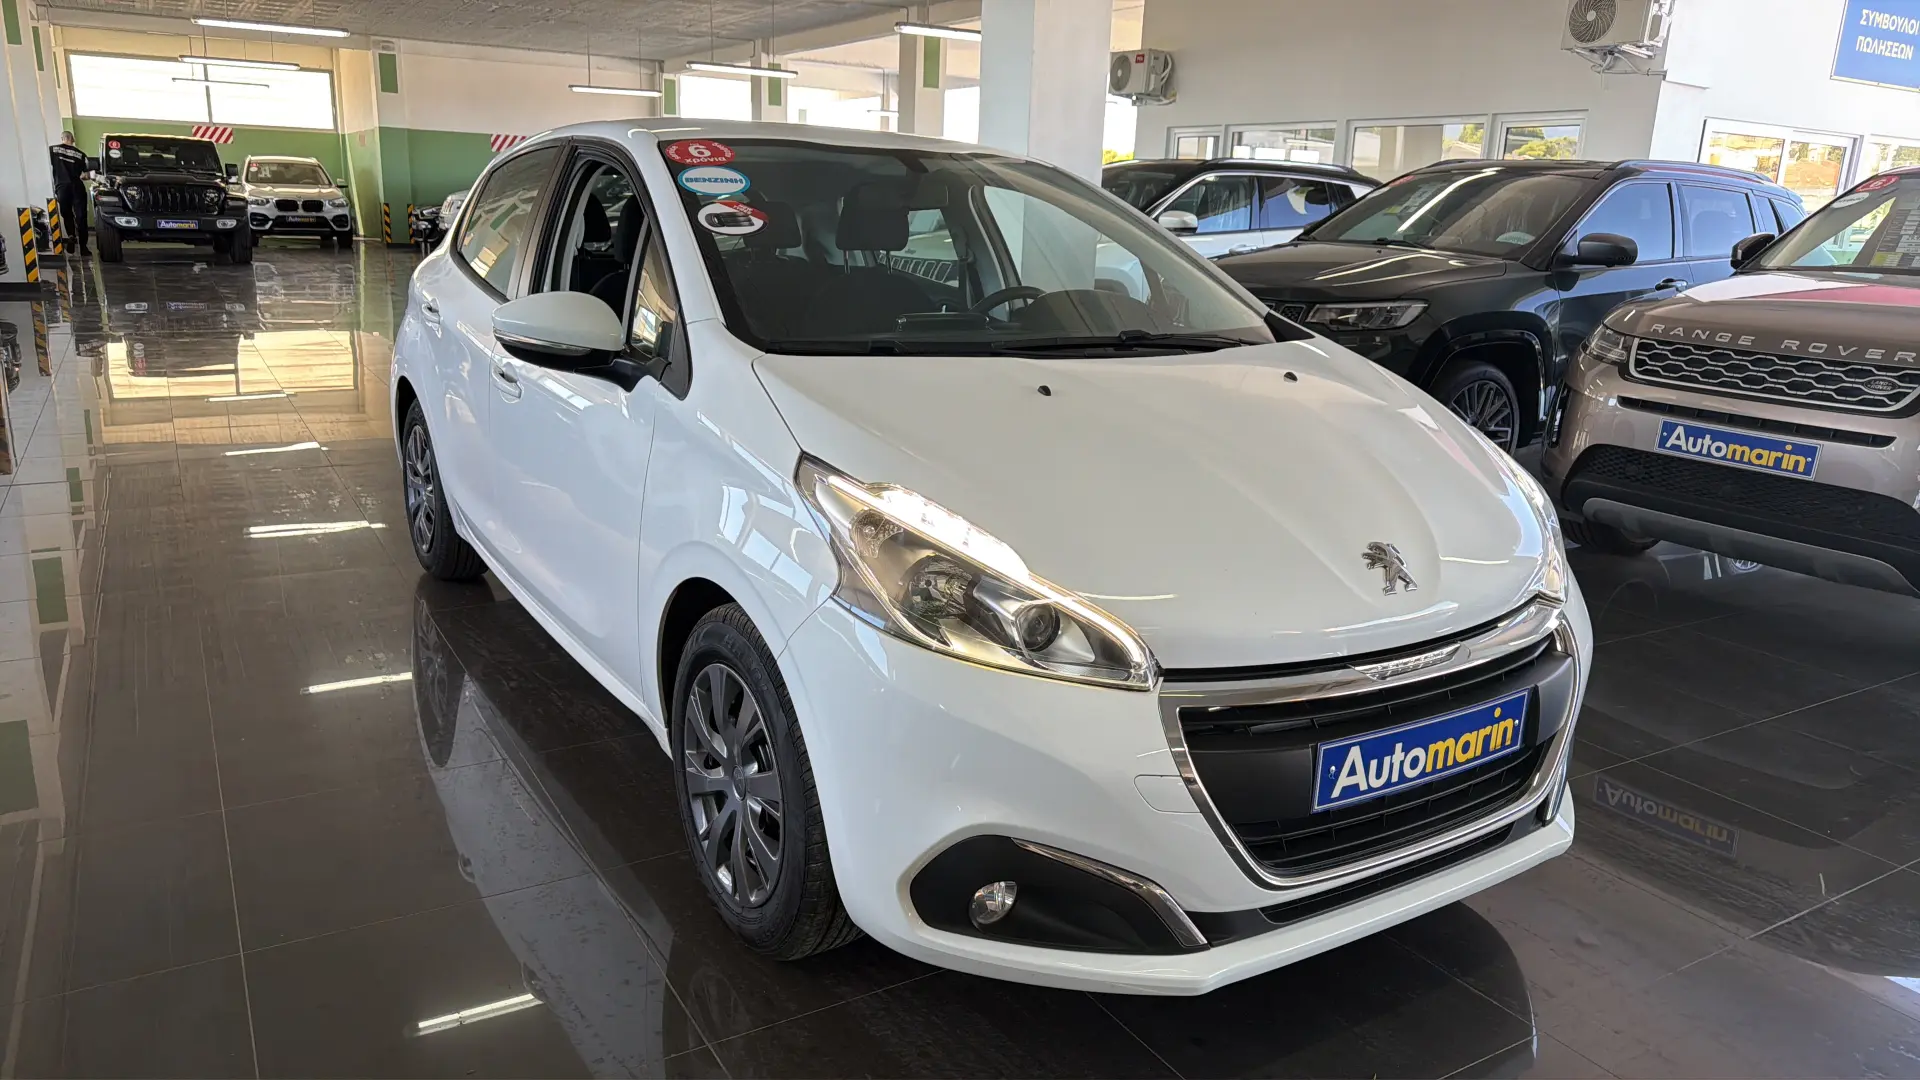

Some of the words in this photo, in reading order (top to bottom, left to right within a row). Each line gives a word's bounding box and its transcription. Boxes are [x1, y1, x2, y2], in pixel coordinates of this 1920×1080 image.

[1860, 9, 1920, 36] ΣΥΜΒΟΥΛΟΙ
[1856, 36, 1914, 60] ΠΩΛΗΣΕΩΝ
[688, 145, 711, 157] 6
[1650, 323, 1755, 346] RANGE
[1780, 339, 1918, 362] ROVER
[1665, 425, 1806, 473] Automarin
[1331, 707, 1513, 798] Automarin
